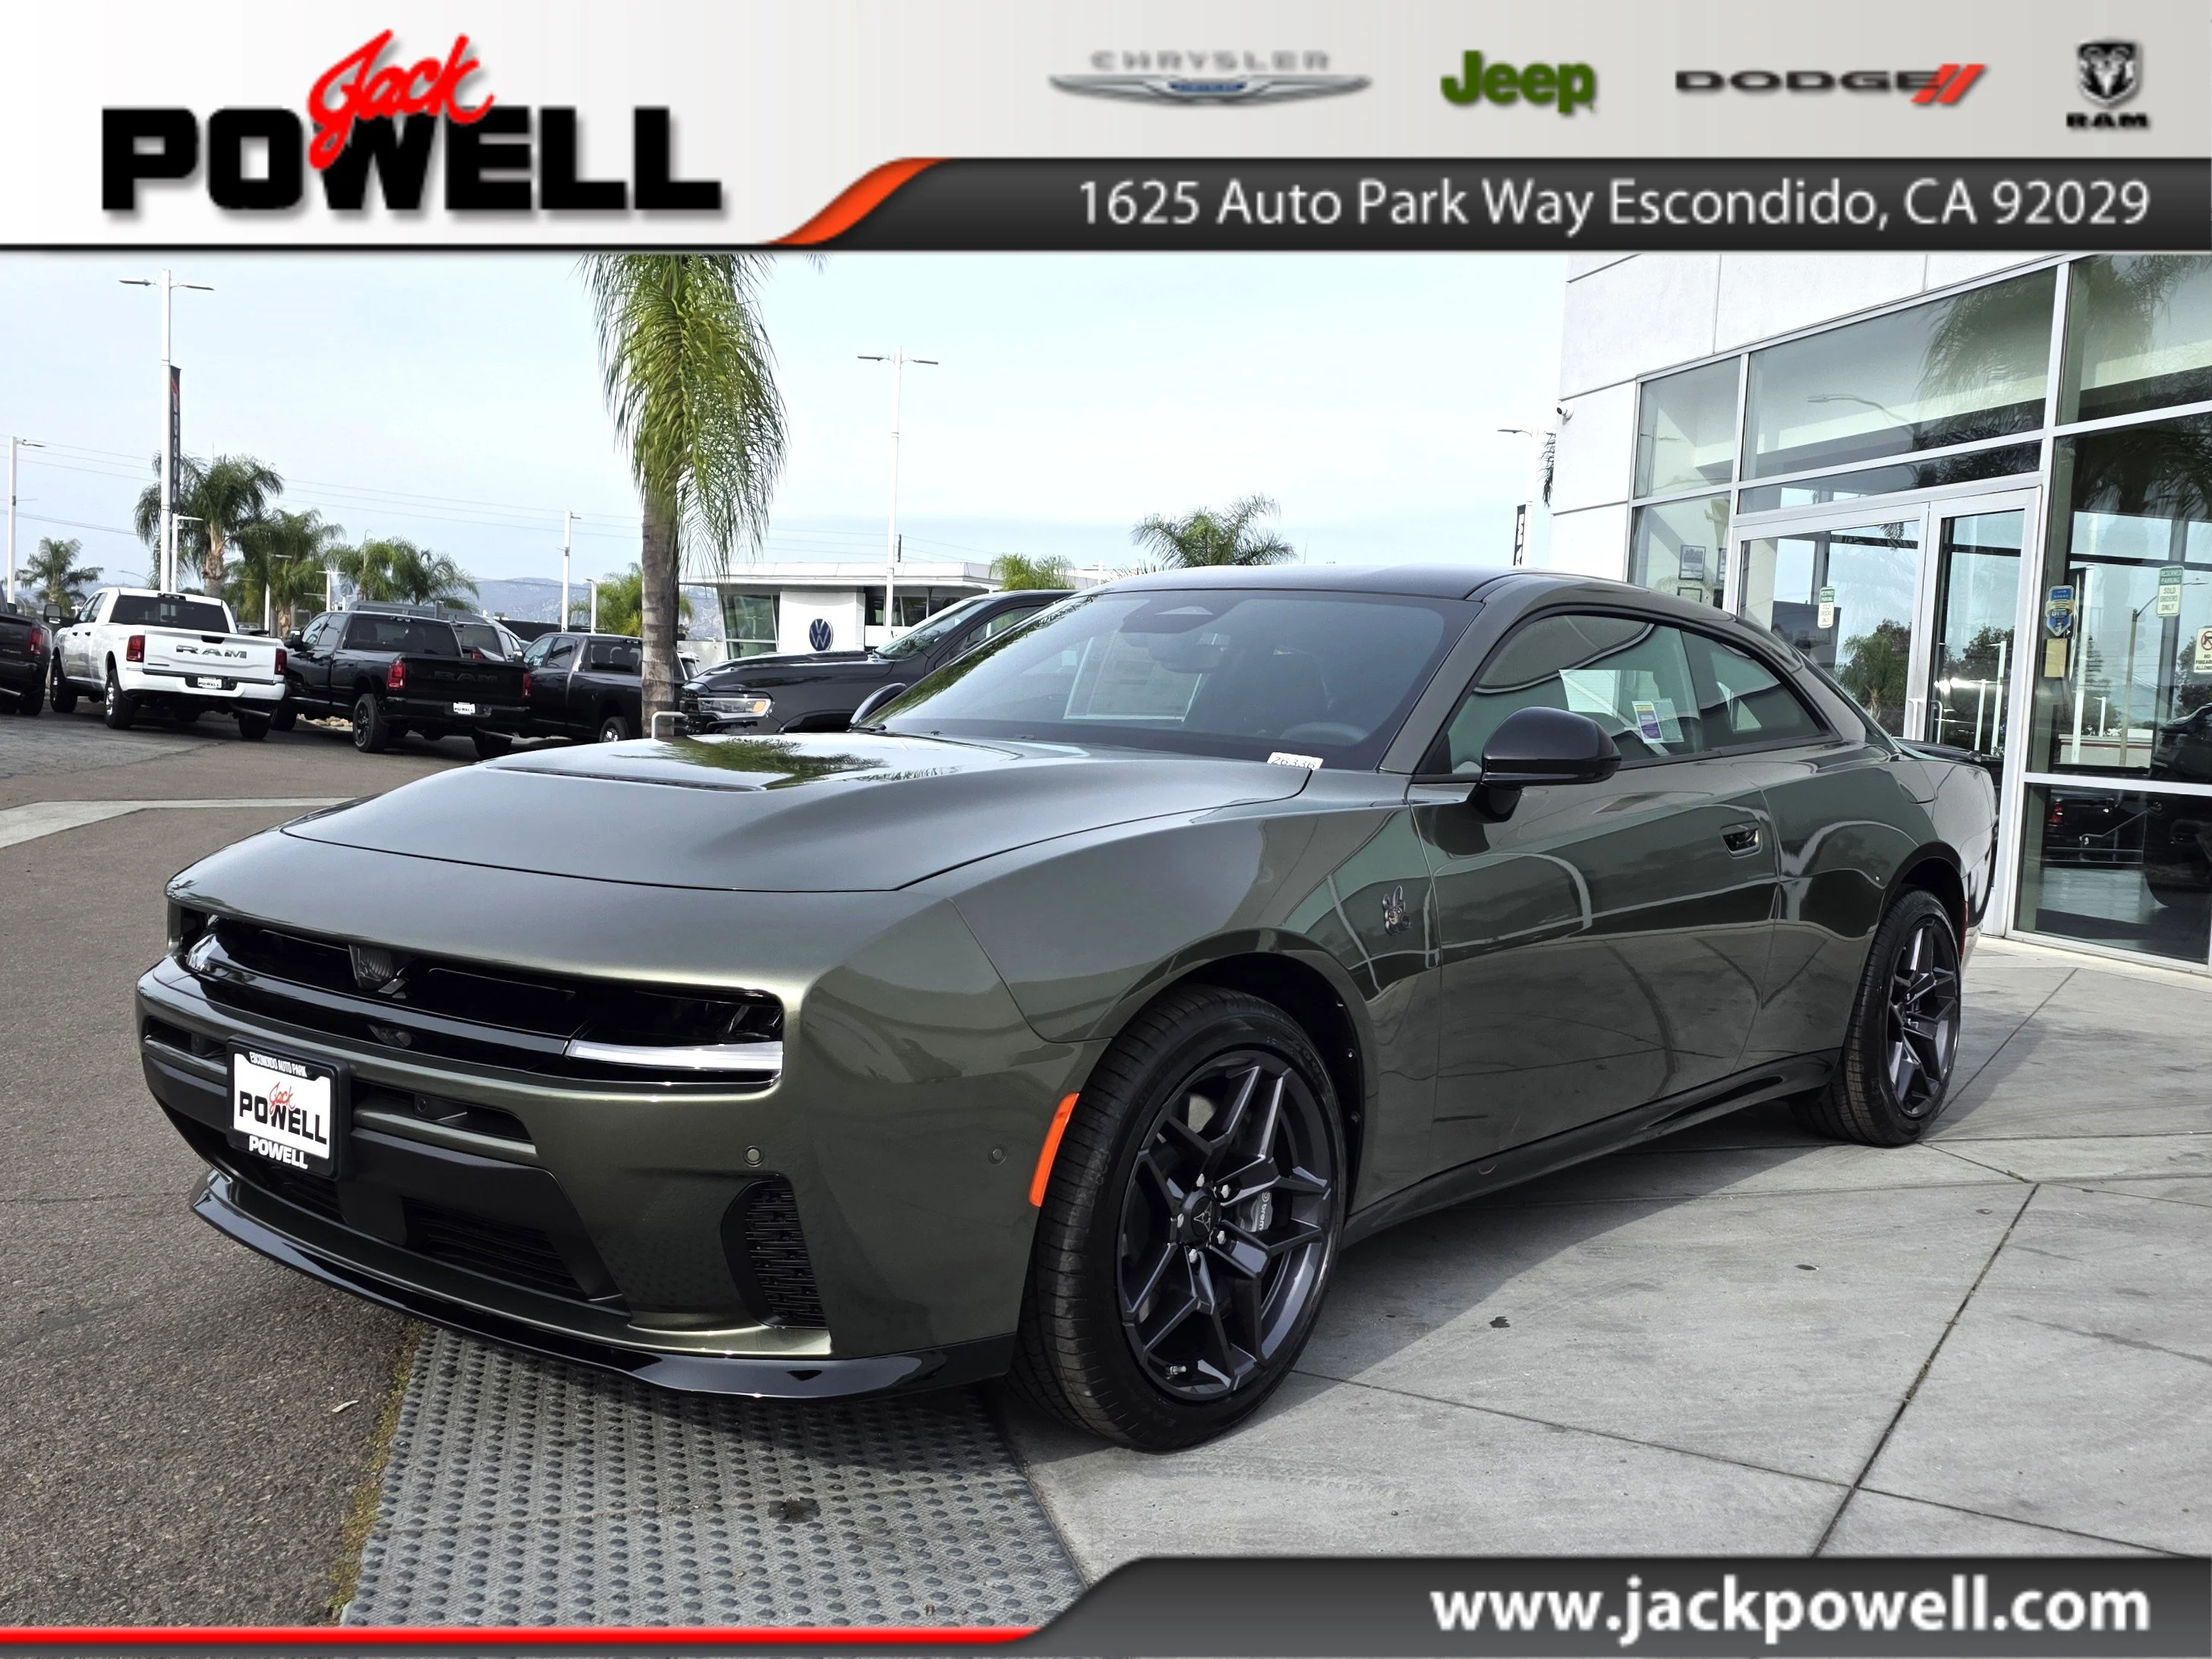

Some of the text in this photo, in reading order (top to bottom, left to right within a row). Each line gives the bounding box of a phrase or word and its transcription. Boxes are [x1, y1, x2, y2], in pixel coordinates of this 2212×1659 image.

[176, 645, 247, 658] RAM
[434, 671, 498, 683] RAM
[291, 1063, 307, 1077] PARK
[269, 1081, 295, 1115] Jack
[239, 1090, 326, 1144] POWELL
[249, 1135, 308, 1169] POWELL
[1259, 1203, 1268, 1231] brem
